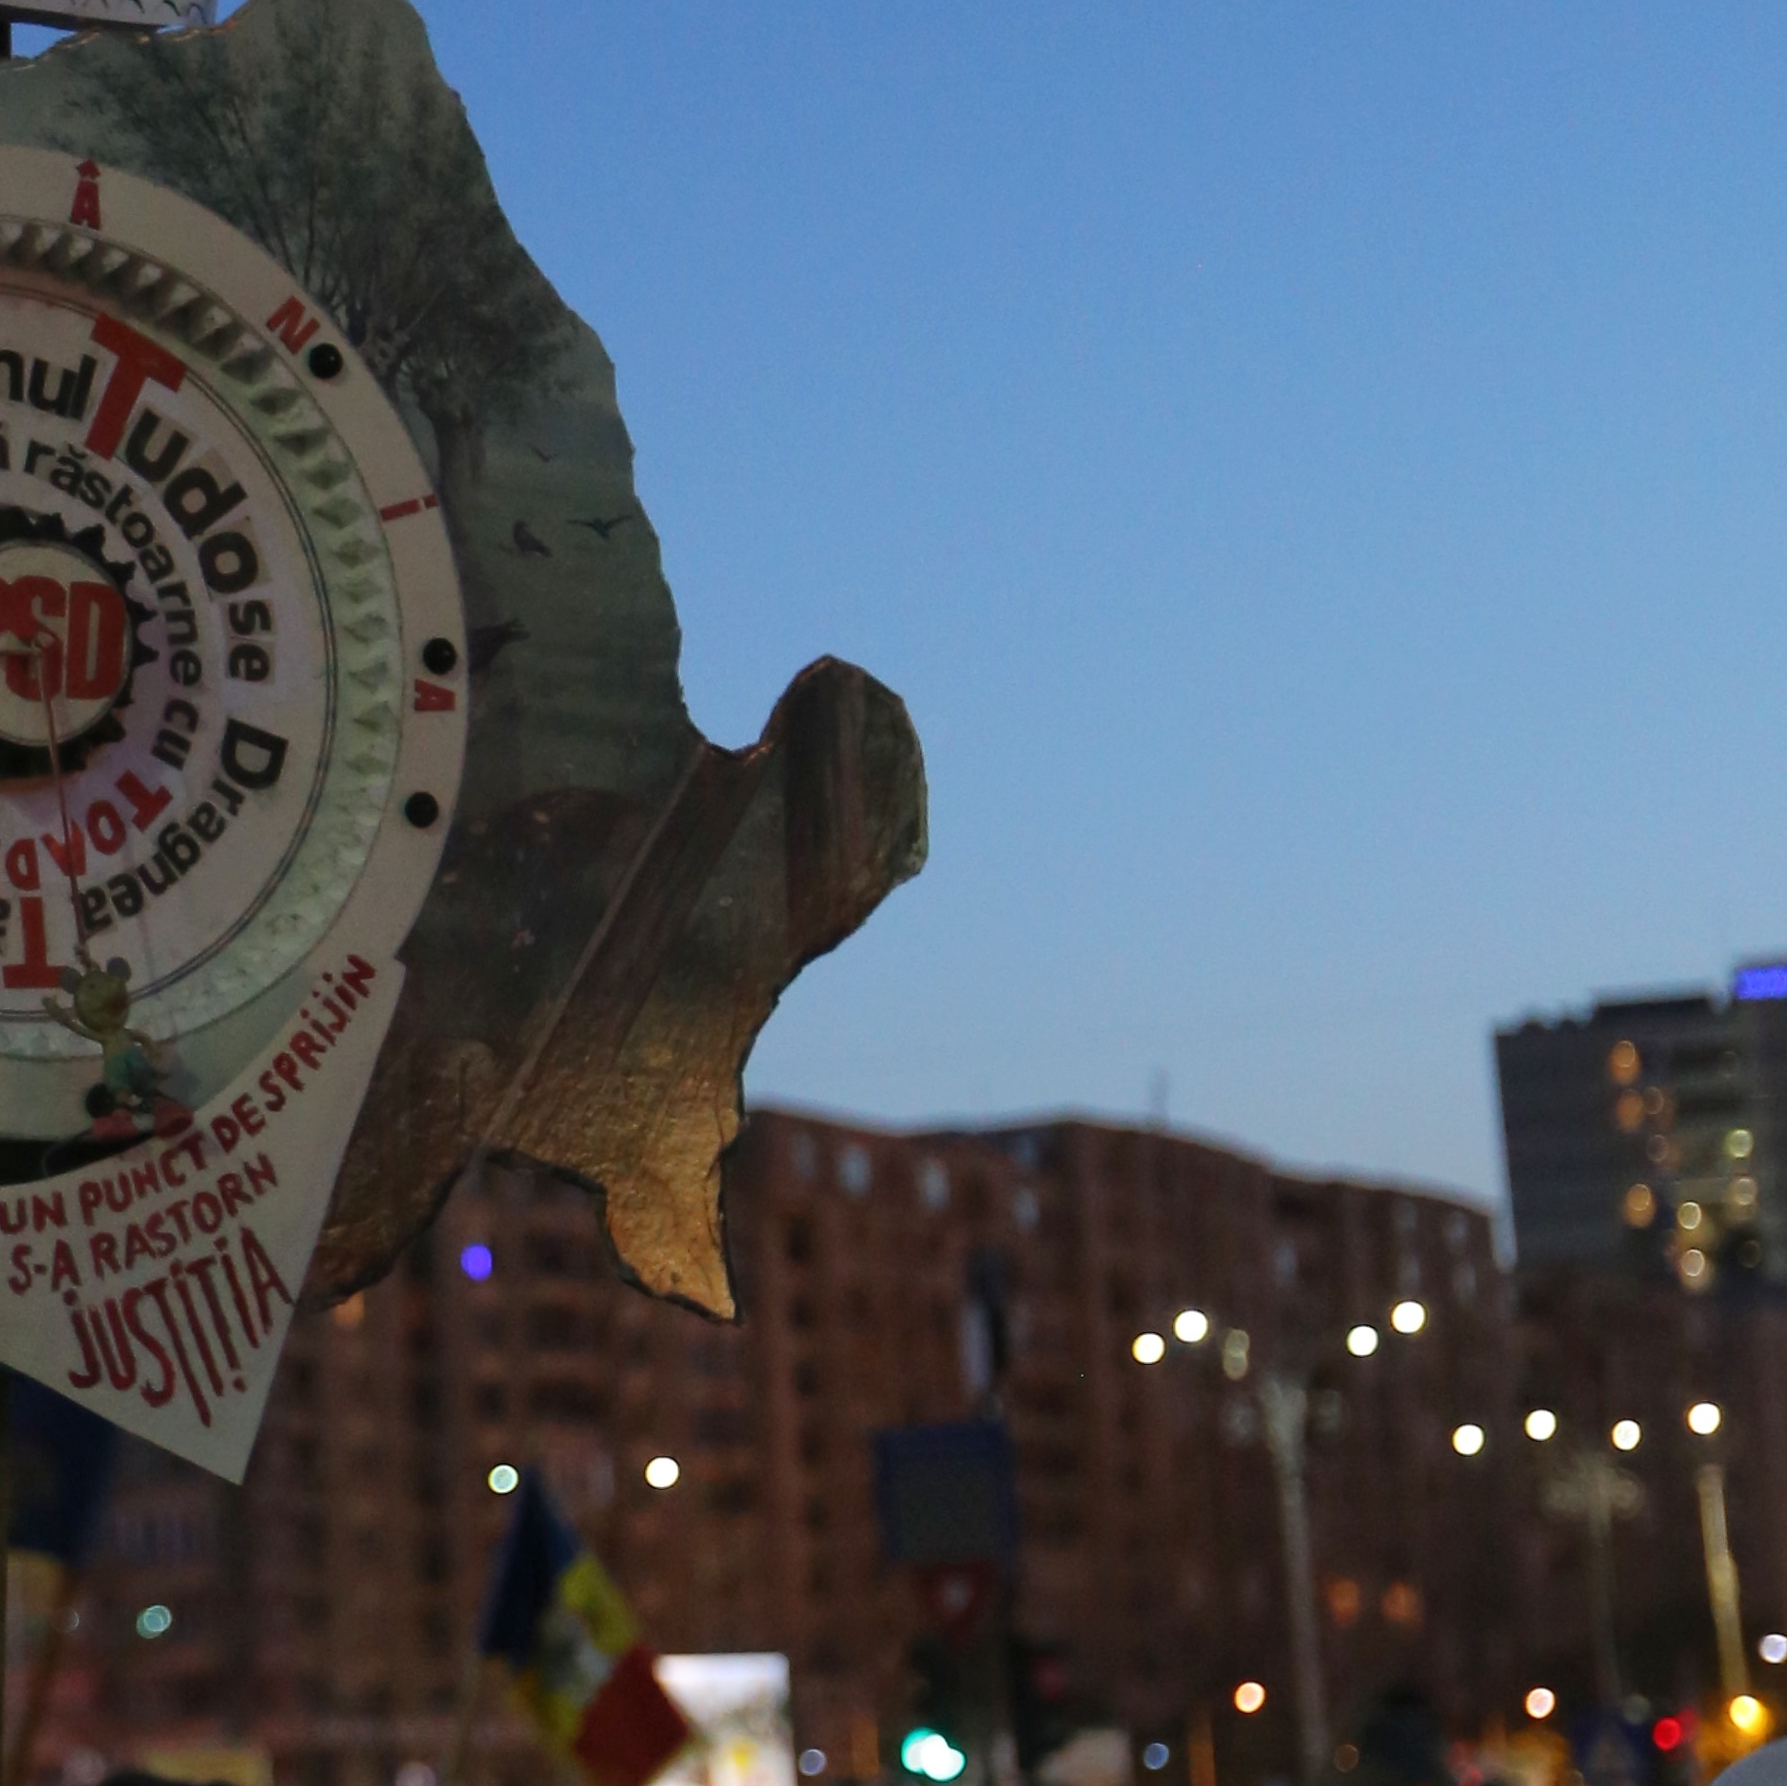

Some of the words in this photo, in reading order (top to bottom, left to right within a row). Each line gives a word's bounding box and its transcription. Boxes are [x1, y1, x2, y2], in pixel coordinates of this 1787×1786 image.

[85, 313, 271, 682] Tudose
[24, 439, 201, 686] răstoarne
[151, 699, 199, 770] cu
[79, 718, 289, 931] Dragnea
[8, 1239, 81, 1295] S-A
[89, 1152, 279, 1281] RASTORN
[211, 1093, 266, 1153] DE
